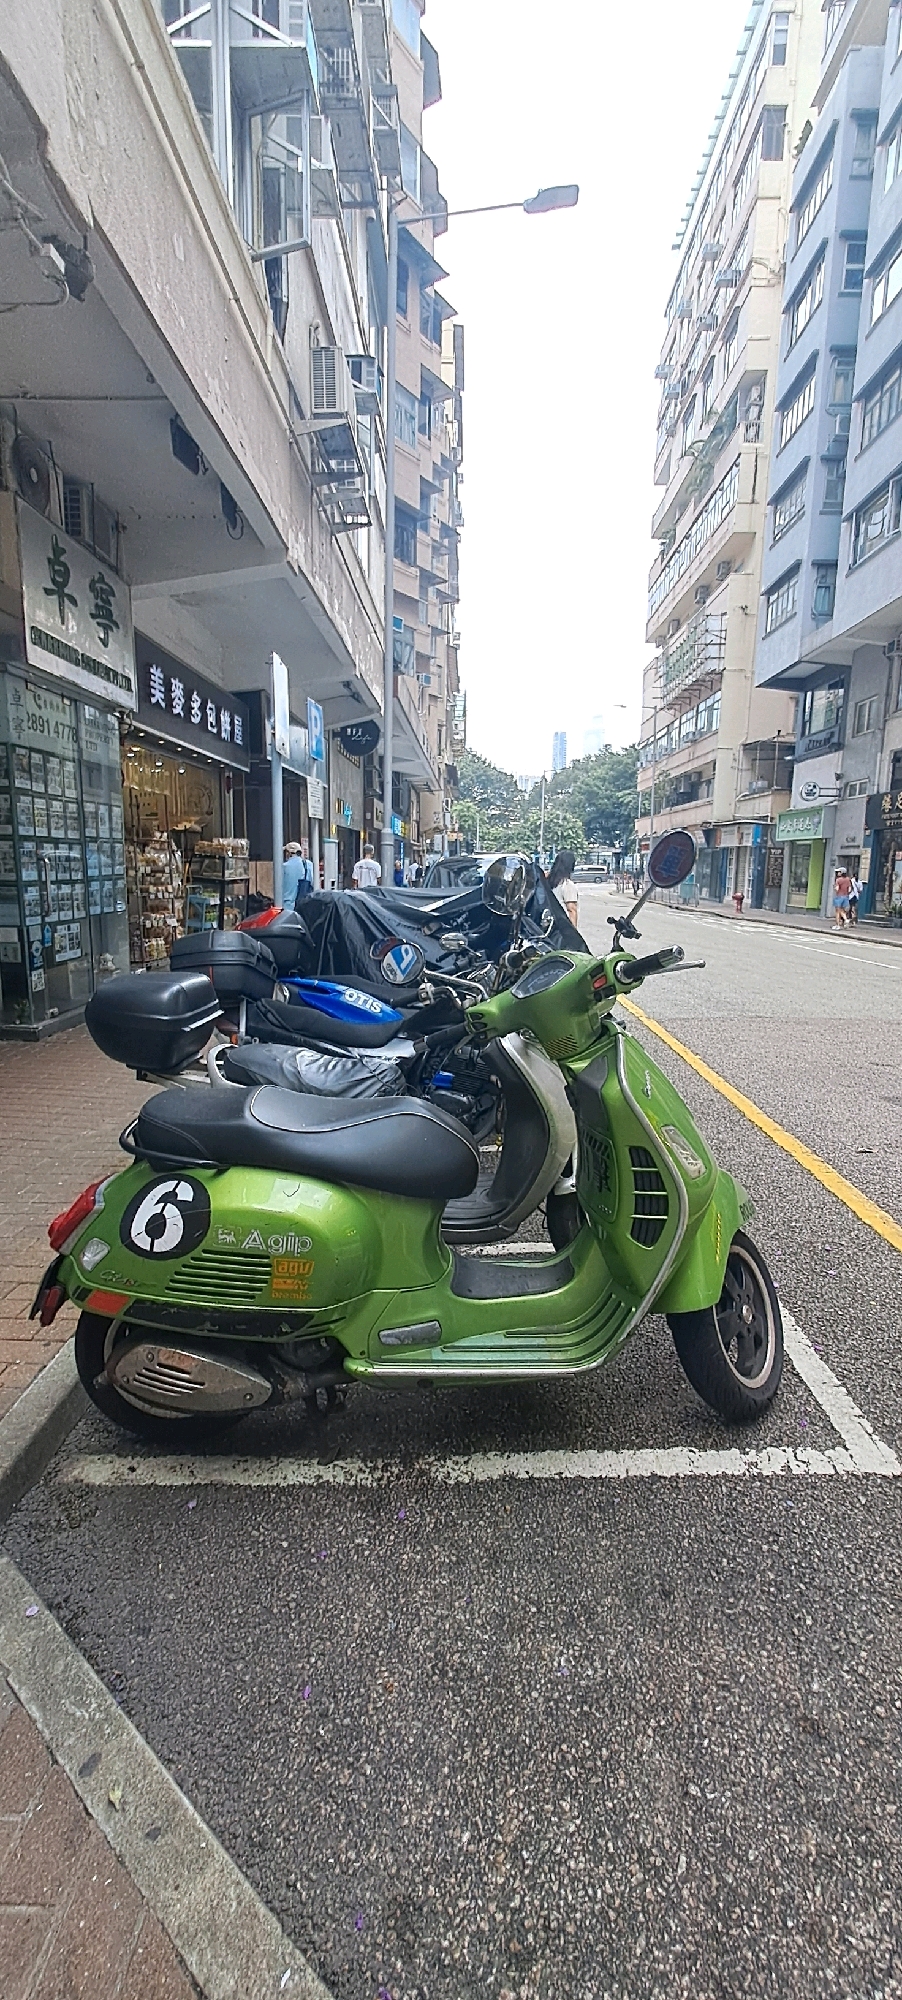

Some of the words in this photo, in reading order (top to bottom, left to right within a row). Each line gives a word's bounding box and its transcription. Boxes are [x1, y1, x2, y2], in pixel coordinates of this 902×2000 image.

[42, 533, 120, 648] 卓寧
[149, 663, 243, 746] 美麥多包餅屋
[310, 706, 321, 752] P
[344, 988, 383, 1014] OTIS
[130, 1179, 194, 1253] 6
[241, 1229, 314, 1257] Agip
